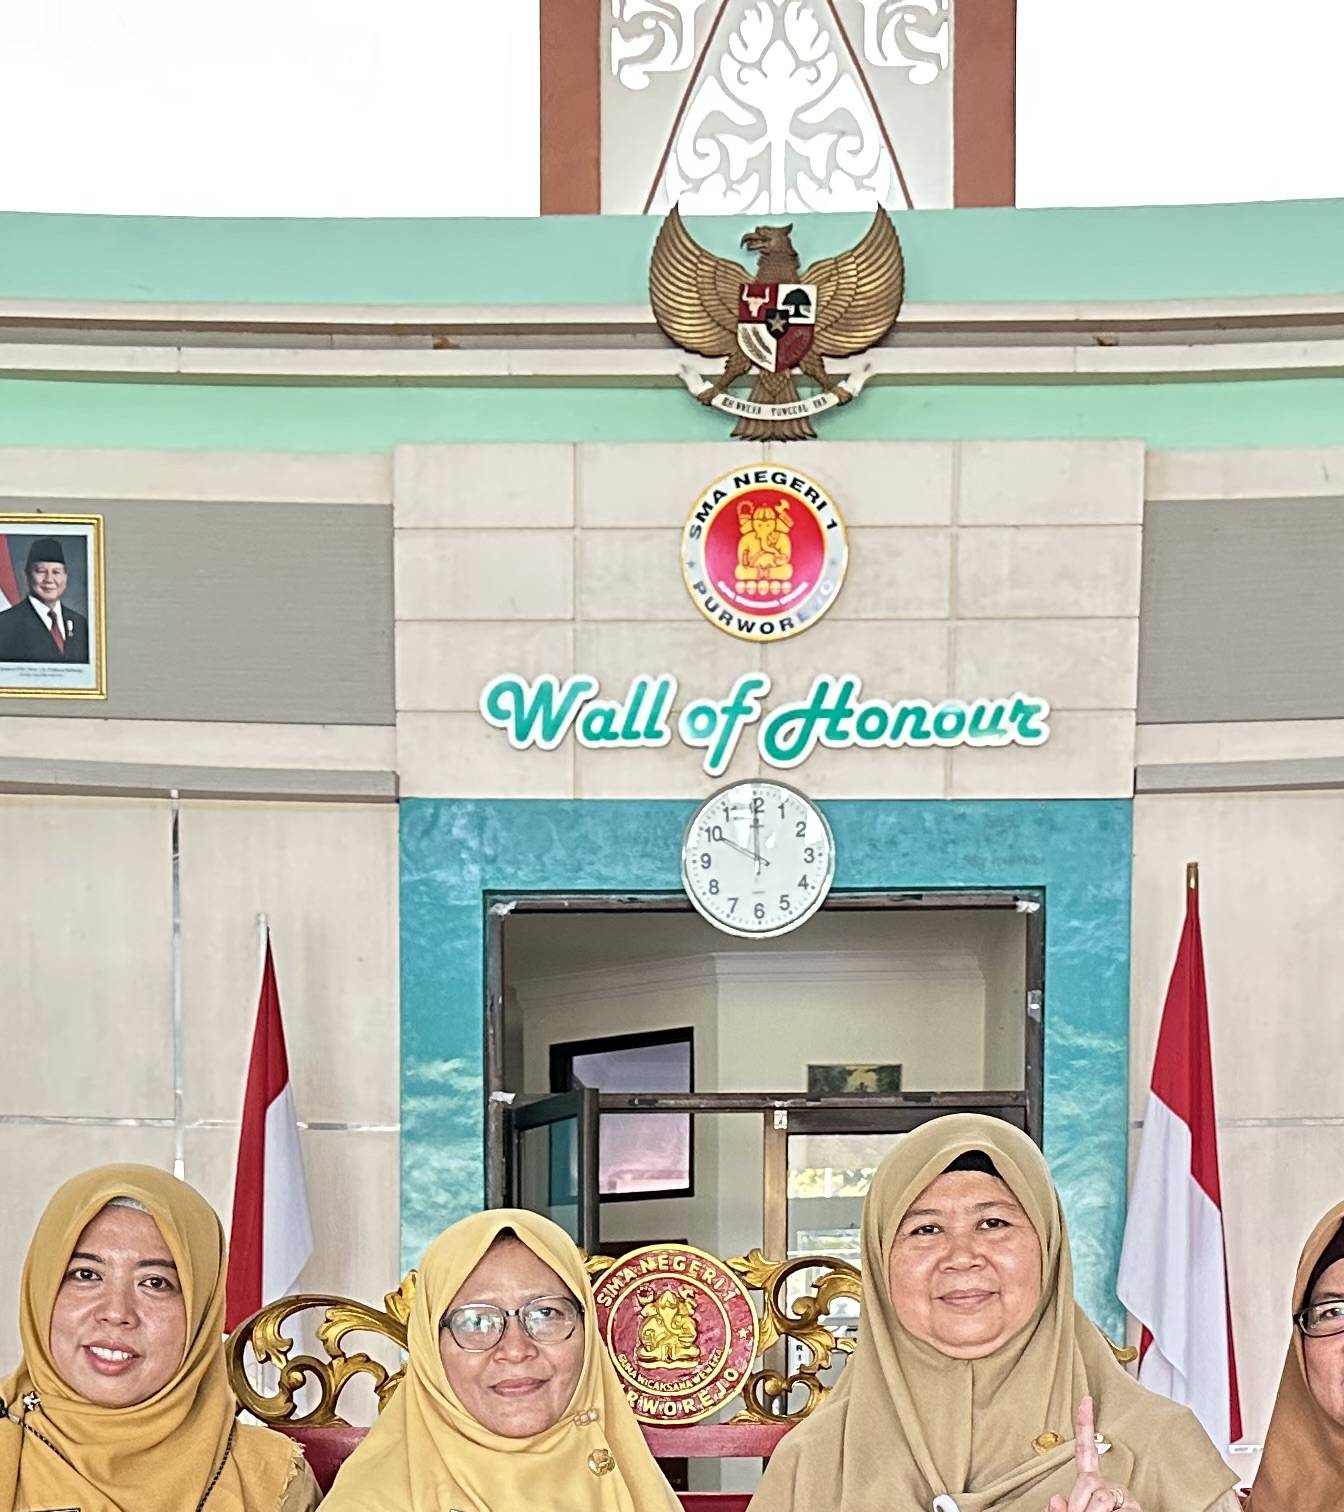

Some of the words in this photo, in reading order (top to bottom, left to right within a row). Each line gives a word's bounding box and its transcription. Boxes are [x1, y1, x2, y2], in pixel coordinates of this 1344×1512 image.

[689, 489, 727, 540] SMA
[733, 470, 828, 511] NEGERI
[826, 519, 838, 531] 1
[485, 676, 673, 747] Wall
[681, 678, 767, 771] of
[764, 678, 1045, 765] Honour
[705, 825, 724, 842] 10
[796, 821, 806, 837] 2
[700, 853, 711, 869] 9
[804, 847, 815, 864] 3
[708, 879, 719, 895] 8
[798, 874, 809, 890] 4
[727, 897, 739, 914] 7
[754, 903, 765, 919] 6
[779, 894, 790, 911] 5
[596, 1267, 637, 1307] SMA
[639, 1254, 726, 1291] NEGERI
[622, 1367, 739, 1416] RWOREJO
